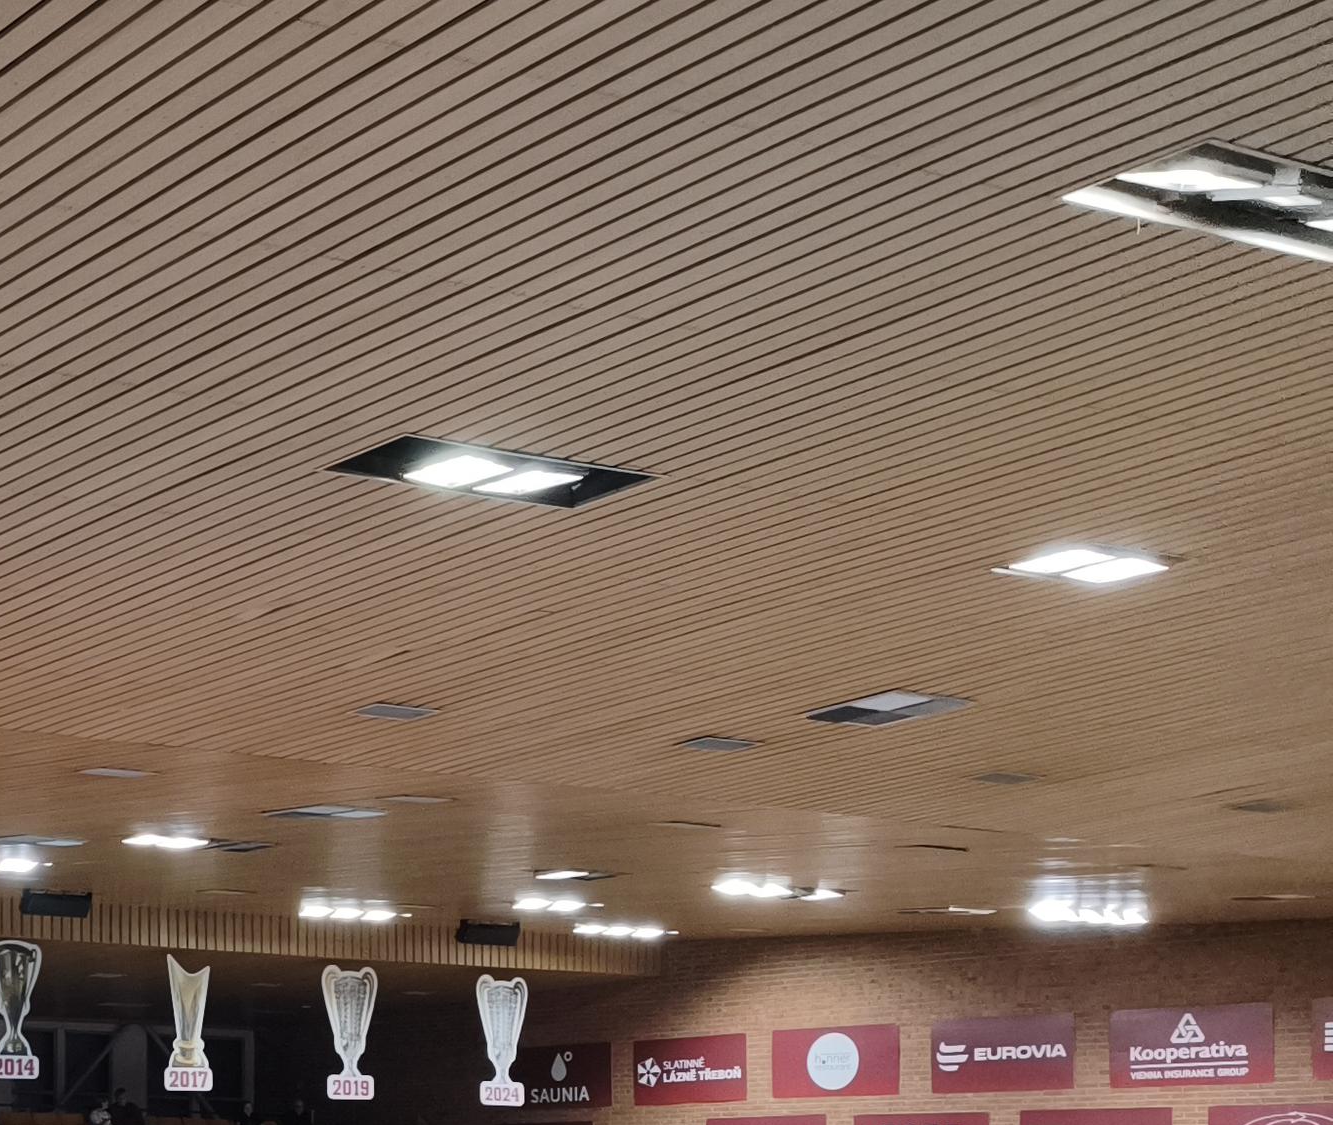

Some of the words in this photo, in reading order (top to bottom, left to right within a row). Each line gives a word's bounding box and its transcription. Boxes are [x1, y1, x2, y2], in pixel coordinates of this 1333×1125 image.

[973, 1044, 1067, 1061] EUROVIA
[1130, 1041, 1248, 1063] Kooperativa
[169, 1071, 207, 1088] 2017
[663, 1068, 697, 1083] LÁZNĚ
[1130, 1071, 1163, 1080] VIENNA
[1164, 1068, 1214, 1079] INSURANCE
[1217, 1067, 1249, 1077] GROUP
[333, 1080, 369, 1096] 2019
[485, 1087, 519, 1102] 2024
[531, 1086, 590, 1103] SAUNIA
